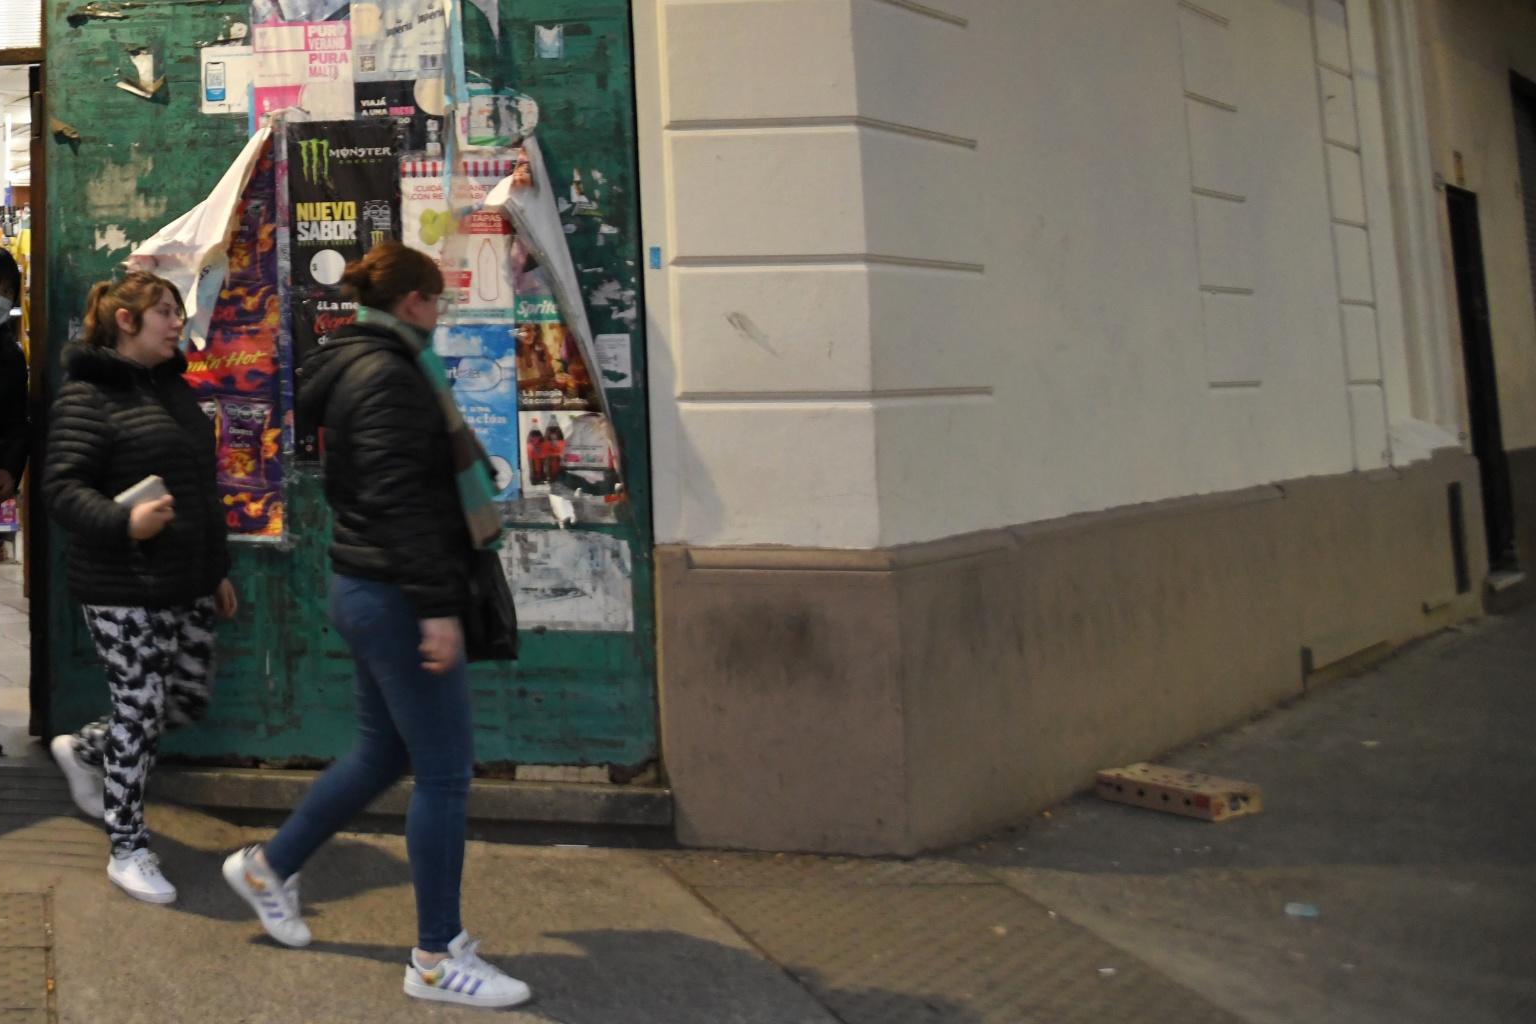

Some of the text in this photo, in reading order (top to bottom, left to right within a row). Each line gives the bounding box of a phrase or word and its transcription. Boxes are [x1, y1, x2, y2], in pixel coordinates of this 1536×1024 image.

[308, 25, 345, 37] PURO
[308, 52, 349, 65] PURA
[329, 146, 392, 158] MONSTER
[296, 201, 358, 221] NUEVO
[297, 220, 357, 242] SABOR
[228, 352, 266, 365] Hot
